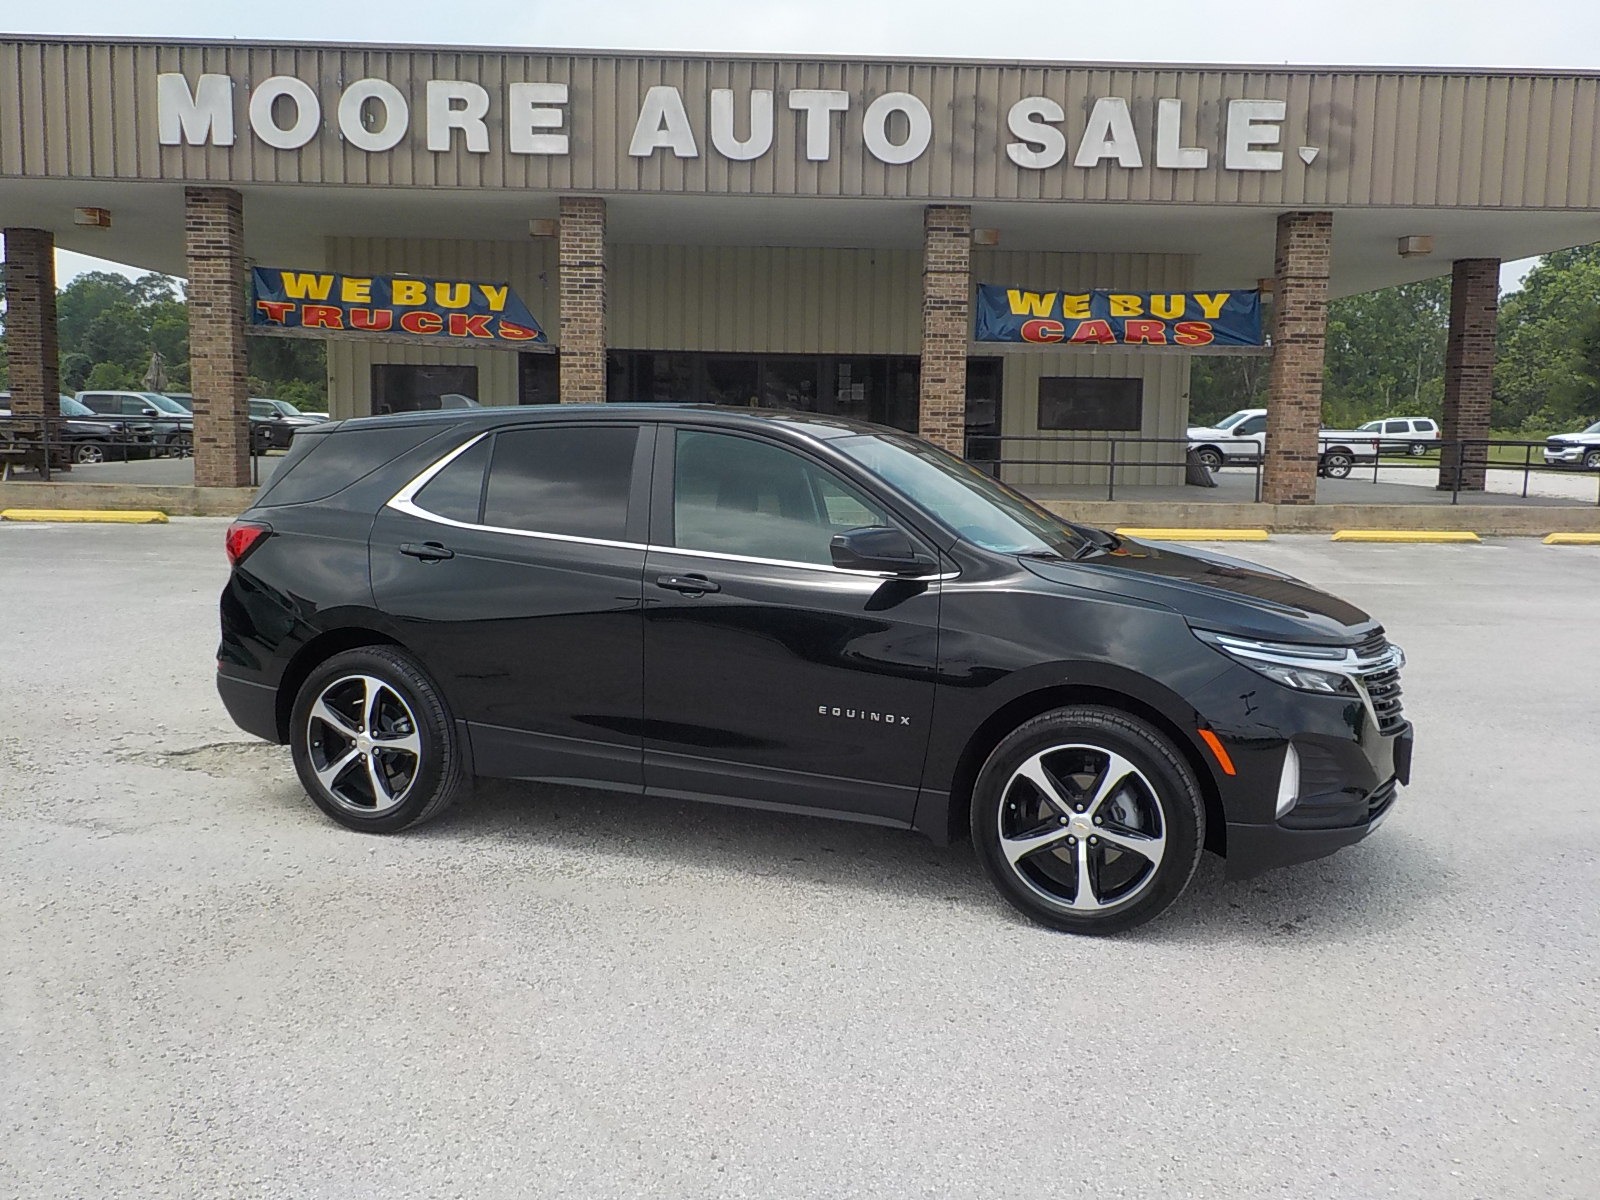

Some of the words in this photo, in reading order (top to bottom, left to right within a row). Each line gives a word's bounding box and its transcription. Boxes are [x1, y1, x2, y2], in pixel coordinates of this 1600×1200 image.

[157, 72, 570, 155] MOORE
[628, 86, 932, 165] AUTO
[1006, 96, 1322, 171] SALE
[280, 272, 372, 303] WE
[391, 279, 509, 312] BUY
[1006, 289, 1092, 319] WE
[1108, 293, 1231, 319] BUY
[257, 301, 539, 341] TRUCKS
[1020, 319, 1215, 346] CARS
[818, 705, 910, 726] EQUINOX
